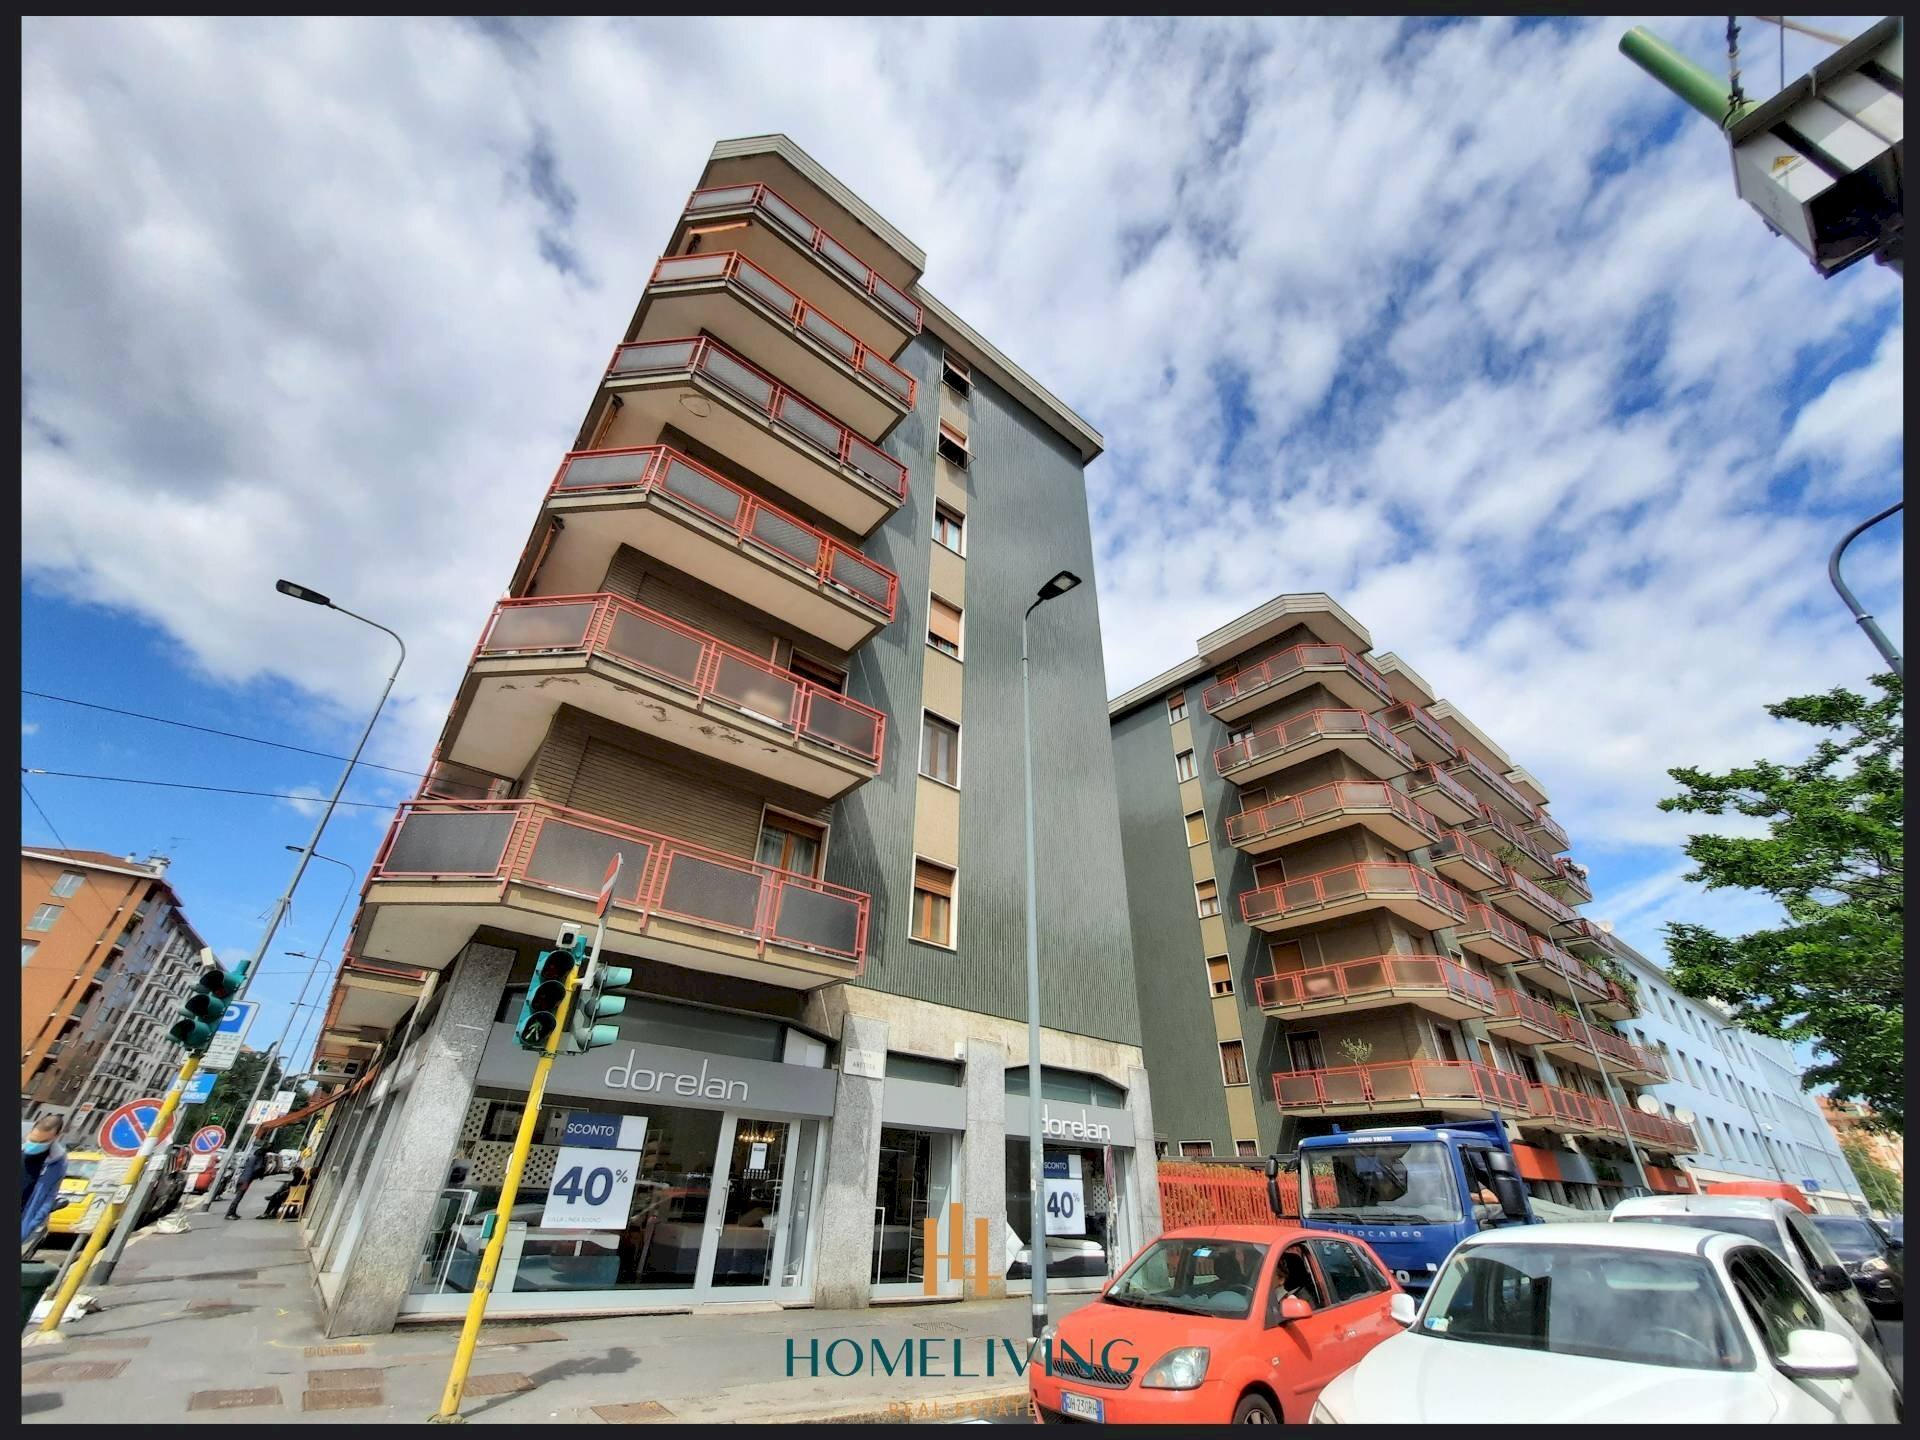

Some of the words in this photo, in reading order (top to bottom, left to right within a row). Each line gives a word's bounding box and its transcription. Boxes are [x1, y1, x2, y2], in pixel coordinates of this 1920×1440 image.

[605, 1049, 749, 1101] dorelan
[567, 1123, 615, 1136] SCONTO
[1042, 1104, 1111, 1140] dorelan
[1044, 1161, 1067, 1170] SCONTO
